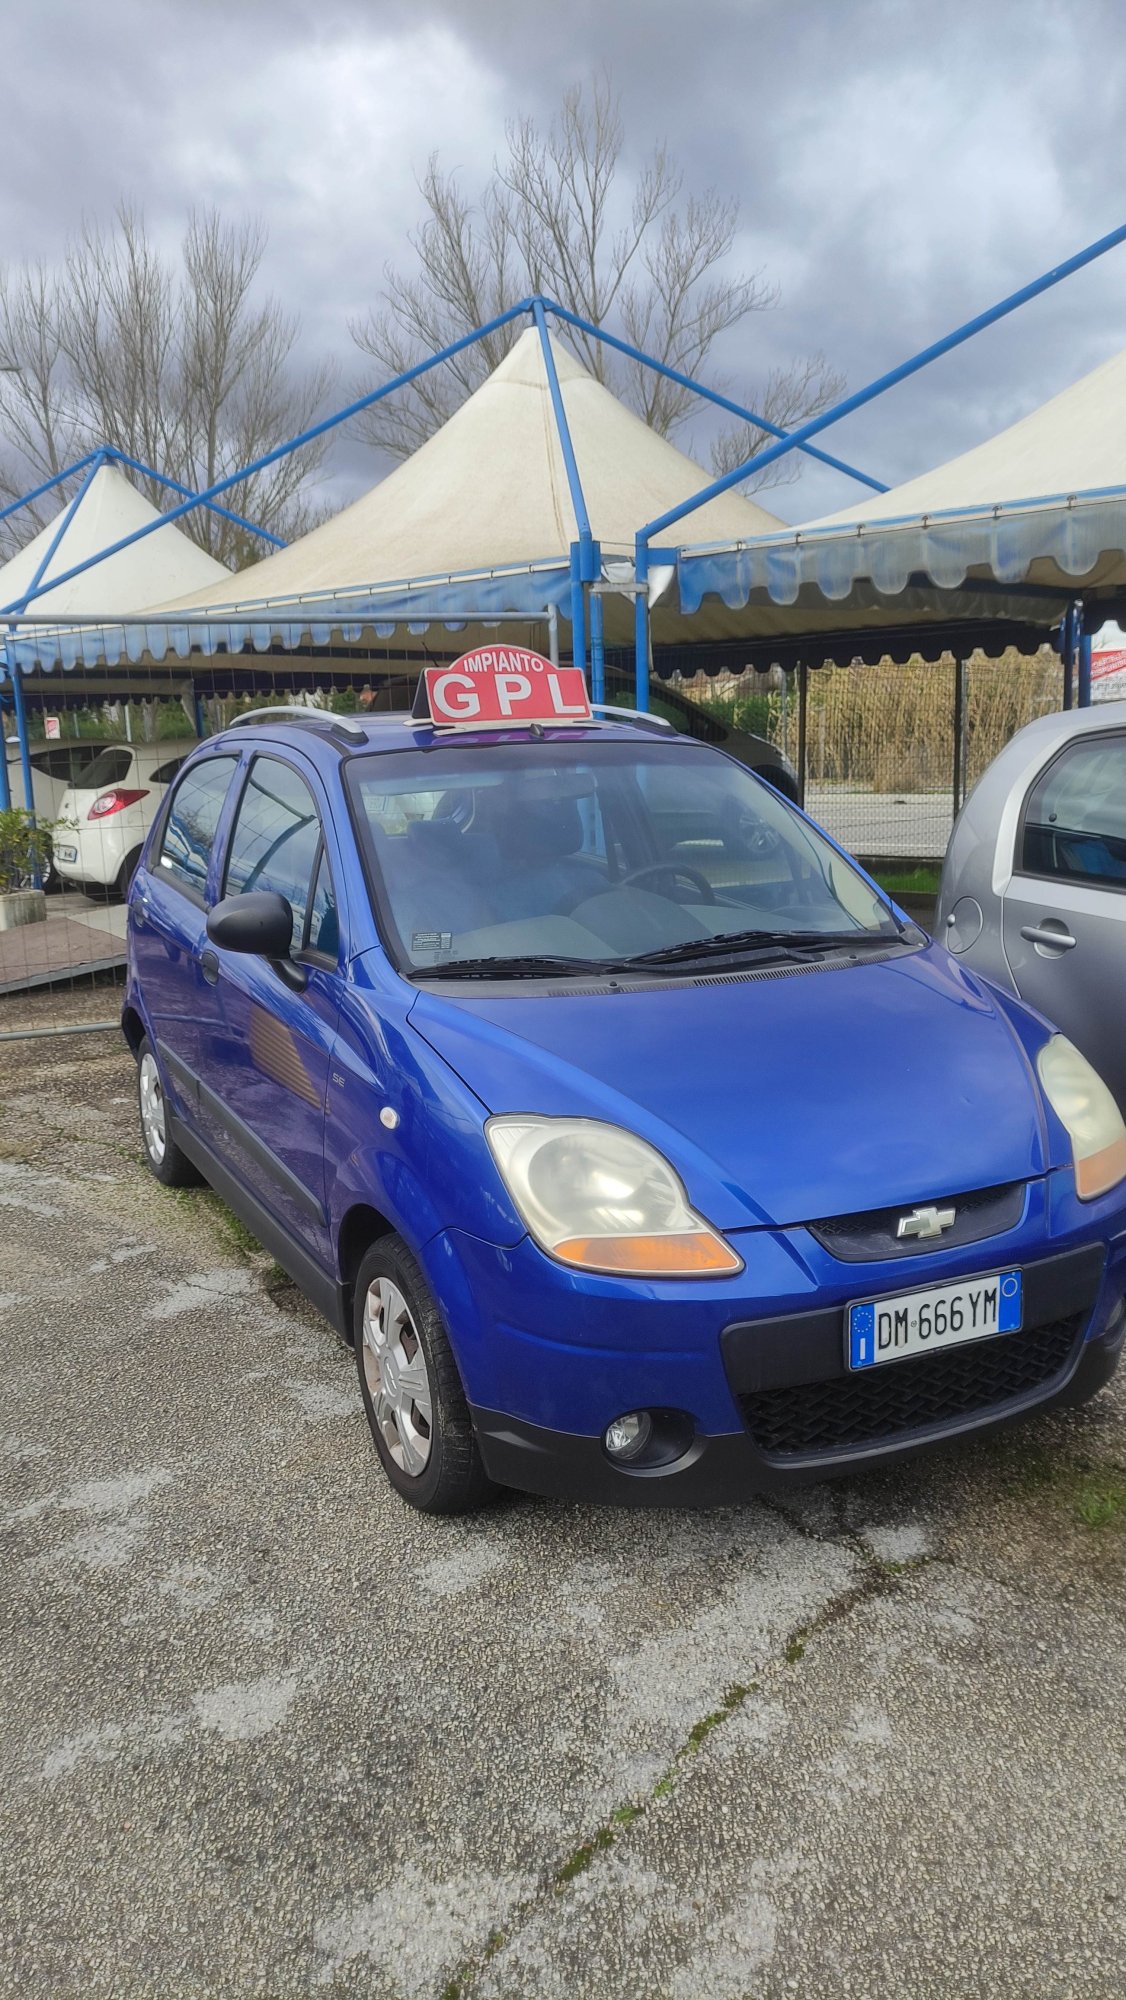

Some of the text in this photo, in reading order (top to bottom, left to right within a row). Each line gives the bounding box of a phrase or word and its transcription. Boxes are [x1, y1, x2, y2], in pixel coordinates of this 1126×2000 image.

[463, 651, 544, 673] IMPIANTO
[433, 673, 587, 719] GPL
[332, 1072, 345, 1088] SE
